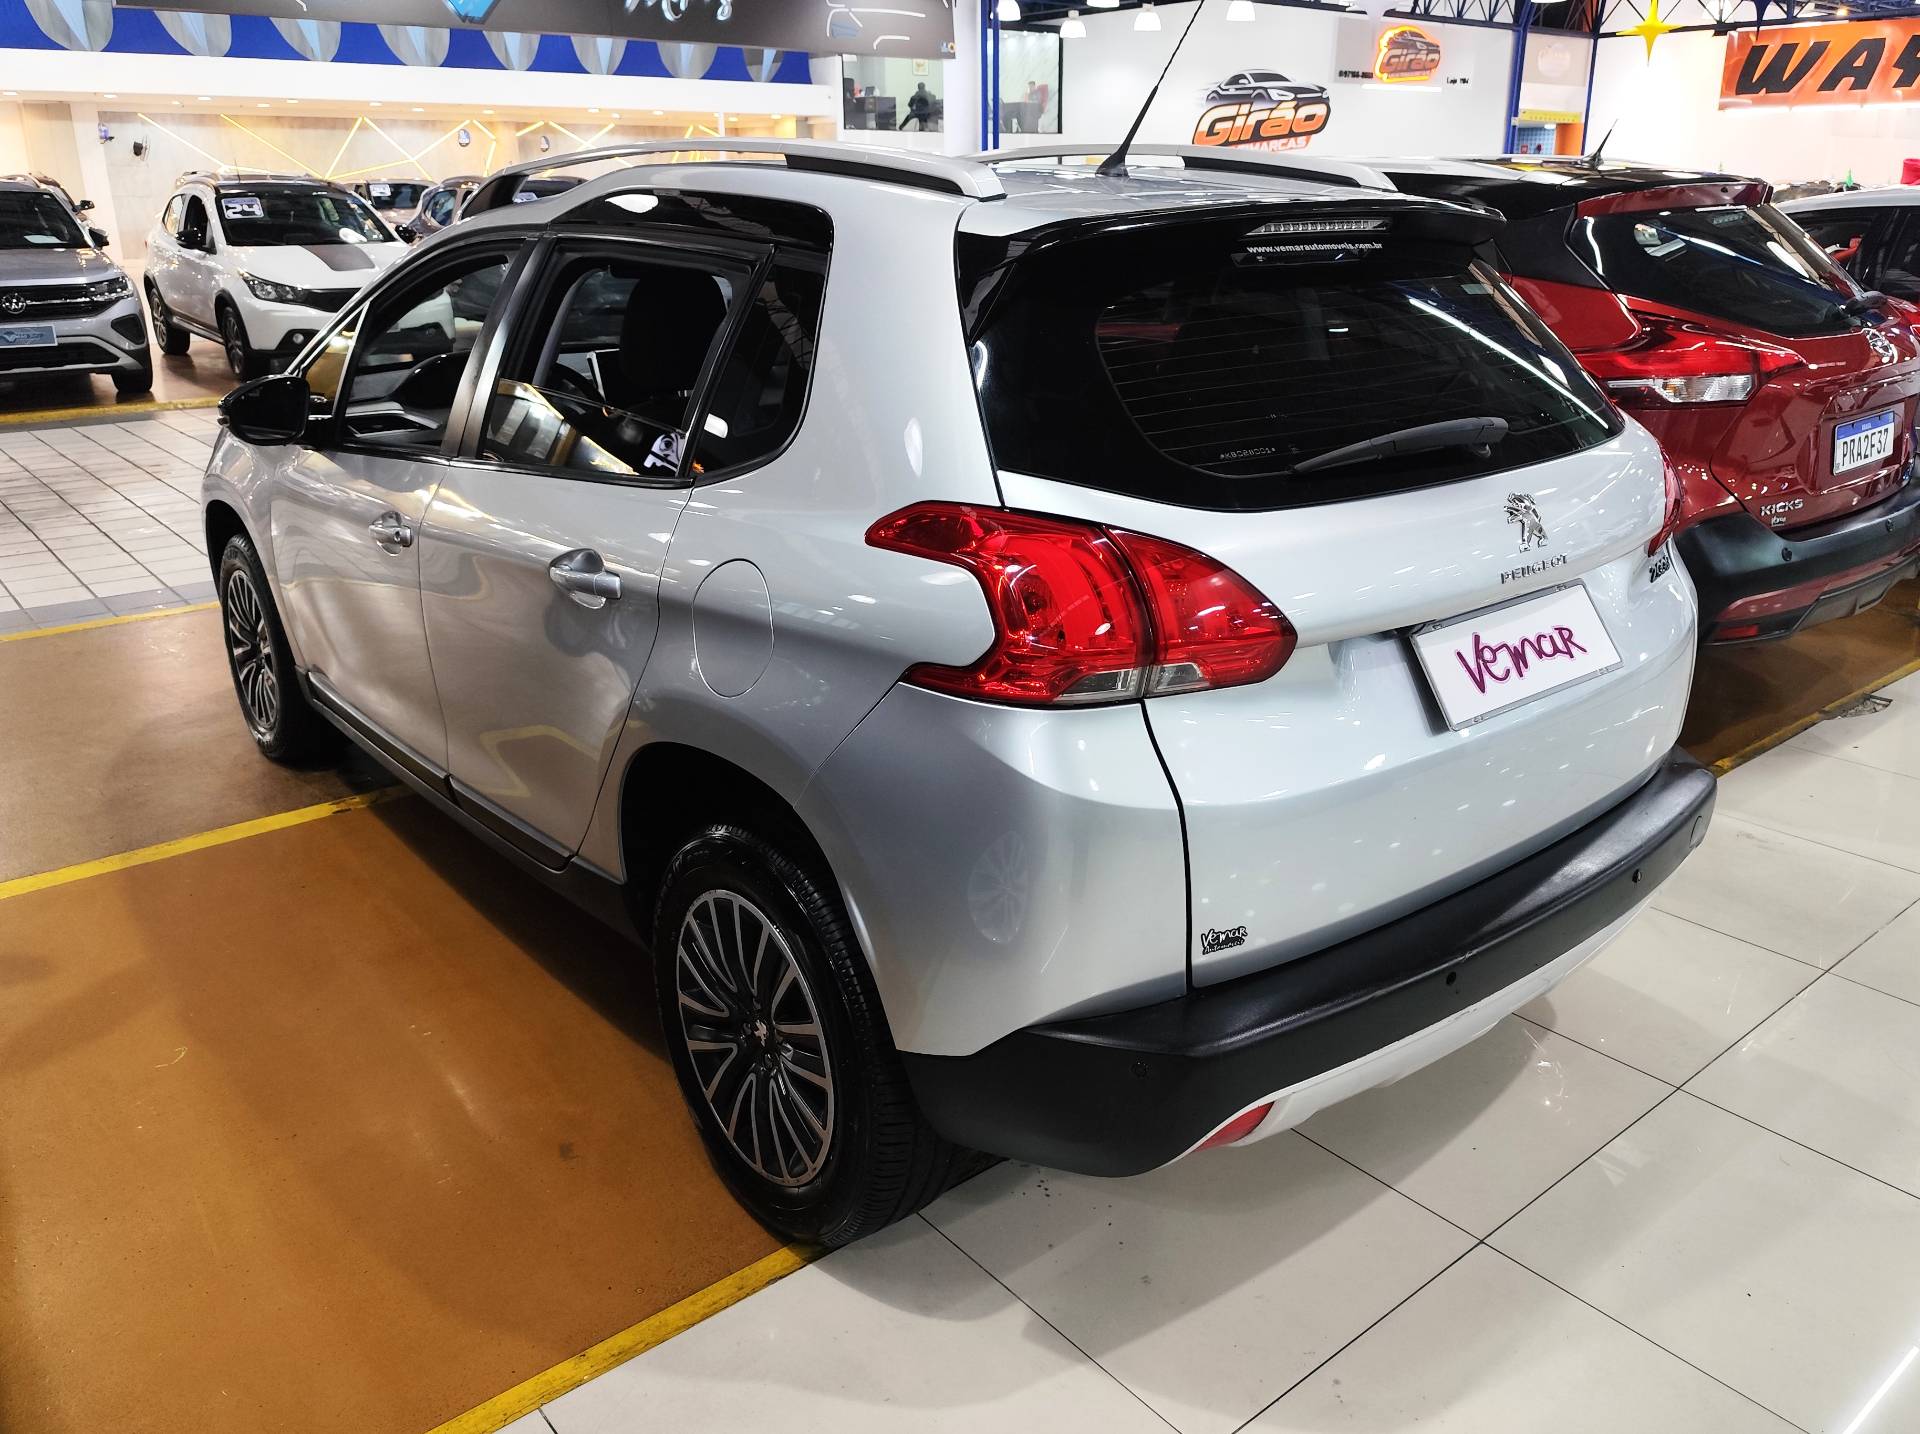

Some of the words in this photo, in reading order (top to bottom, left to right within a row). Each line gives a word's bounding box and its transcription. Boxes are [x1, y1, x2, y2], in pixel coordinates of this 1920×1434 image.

[1842, 427, 1889, 467] PRA2F37
[1760, 498, 1804, 517] KICKS
[1500, 553, 1568, 584] PEUGEOT
